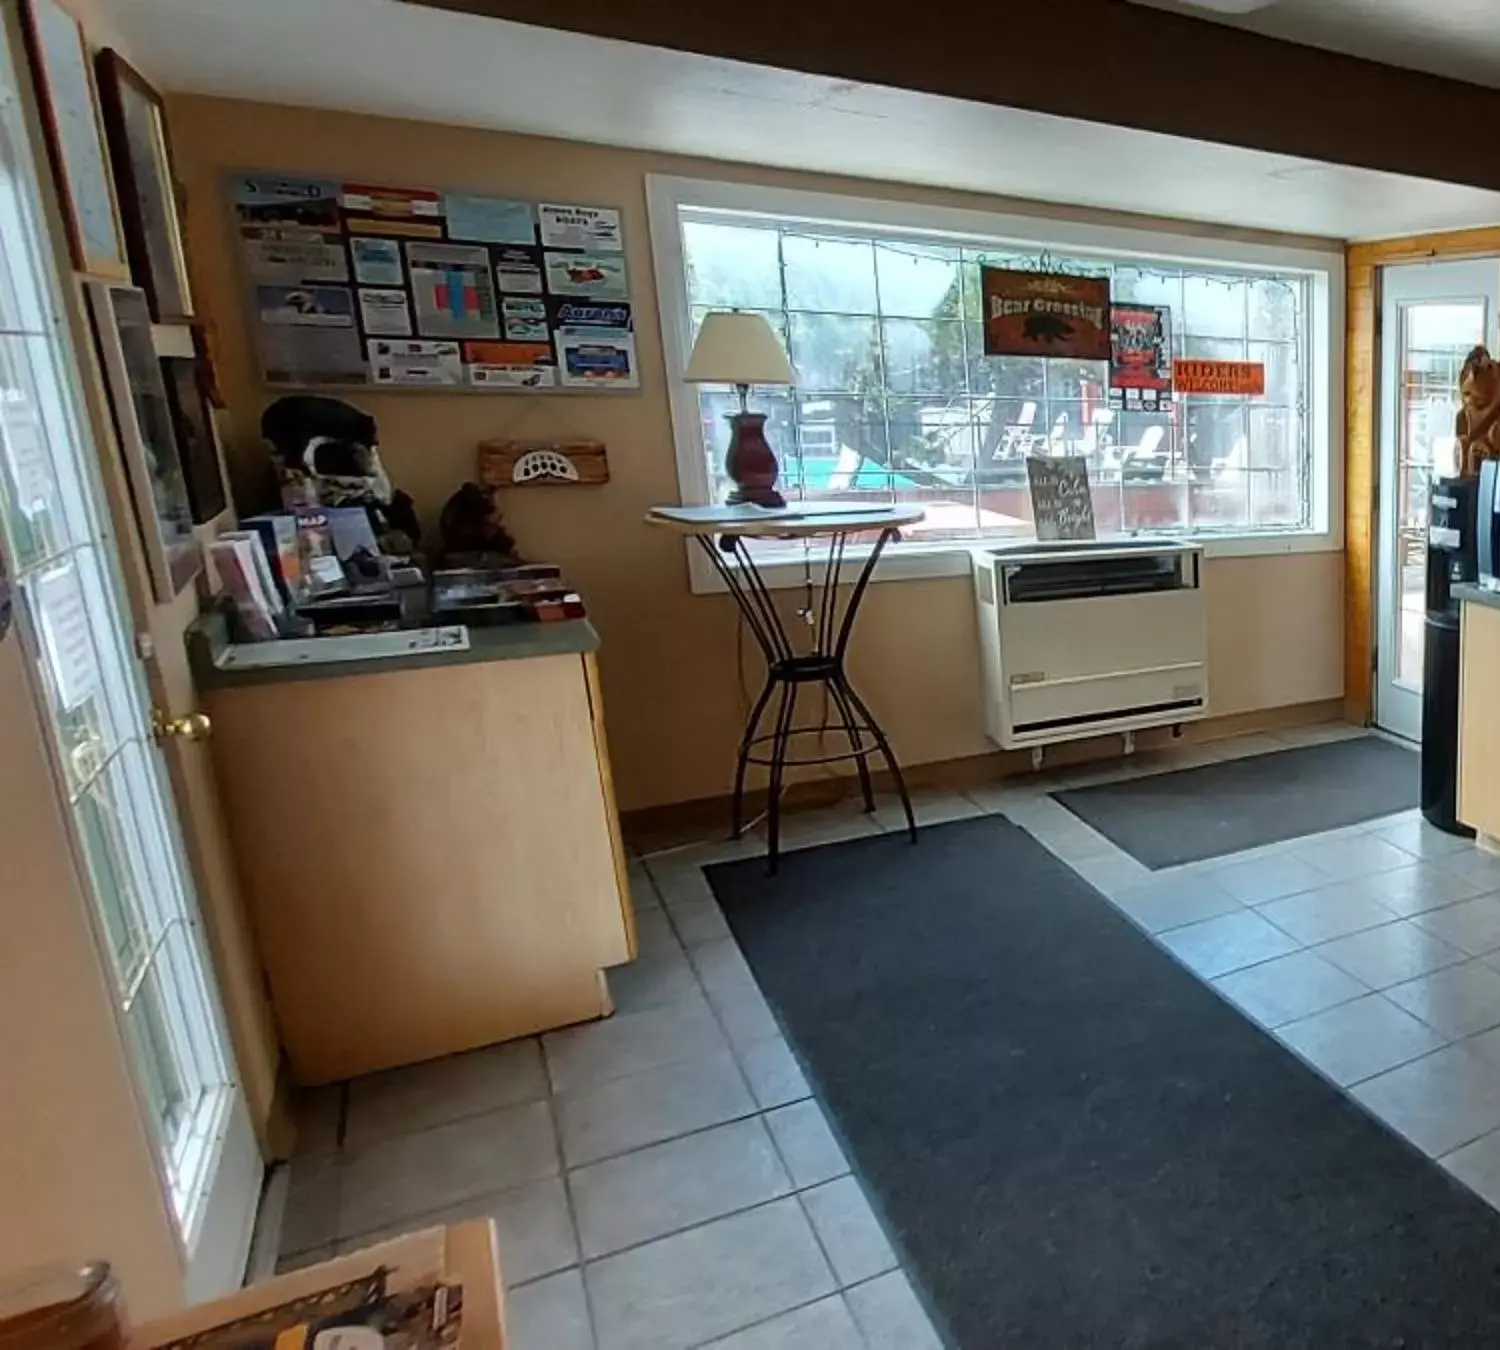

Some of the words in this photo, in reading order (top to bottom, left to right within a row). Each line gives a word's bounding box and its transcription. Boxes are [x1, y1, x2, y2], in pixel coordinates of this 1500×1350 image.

[991, 295, 1031, 320] Bear
[1033, 298, 1103, 331] Crossing
[1177, 363, 1251, 377] RIDERS
